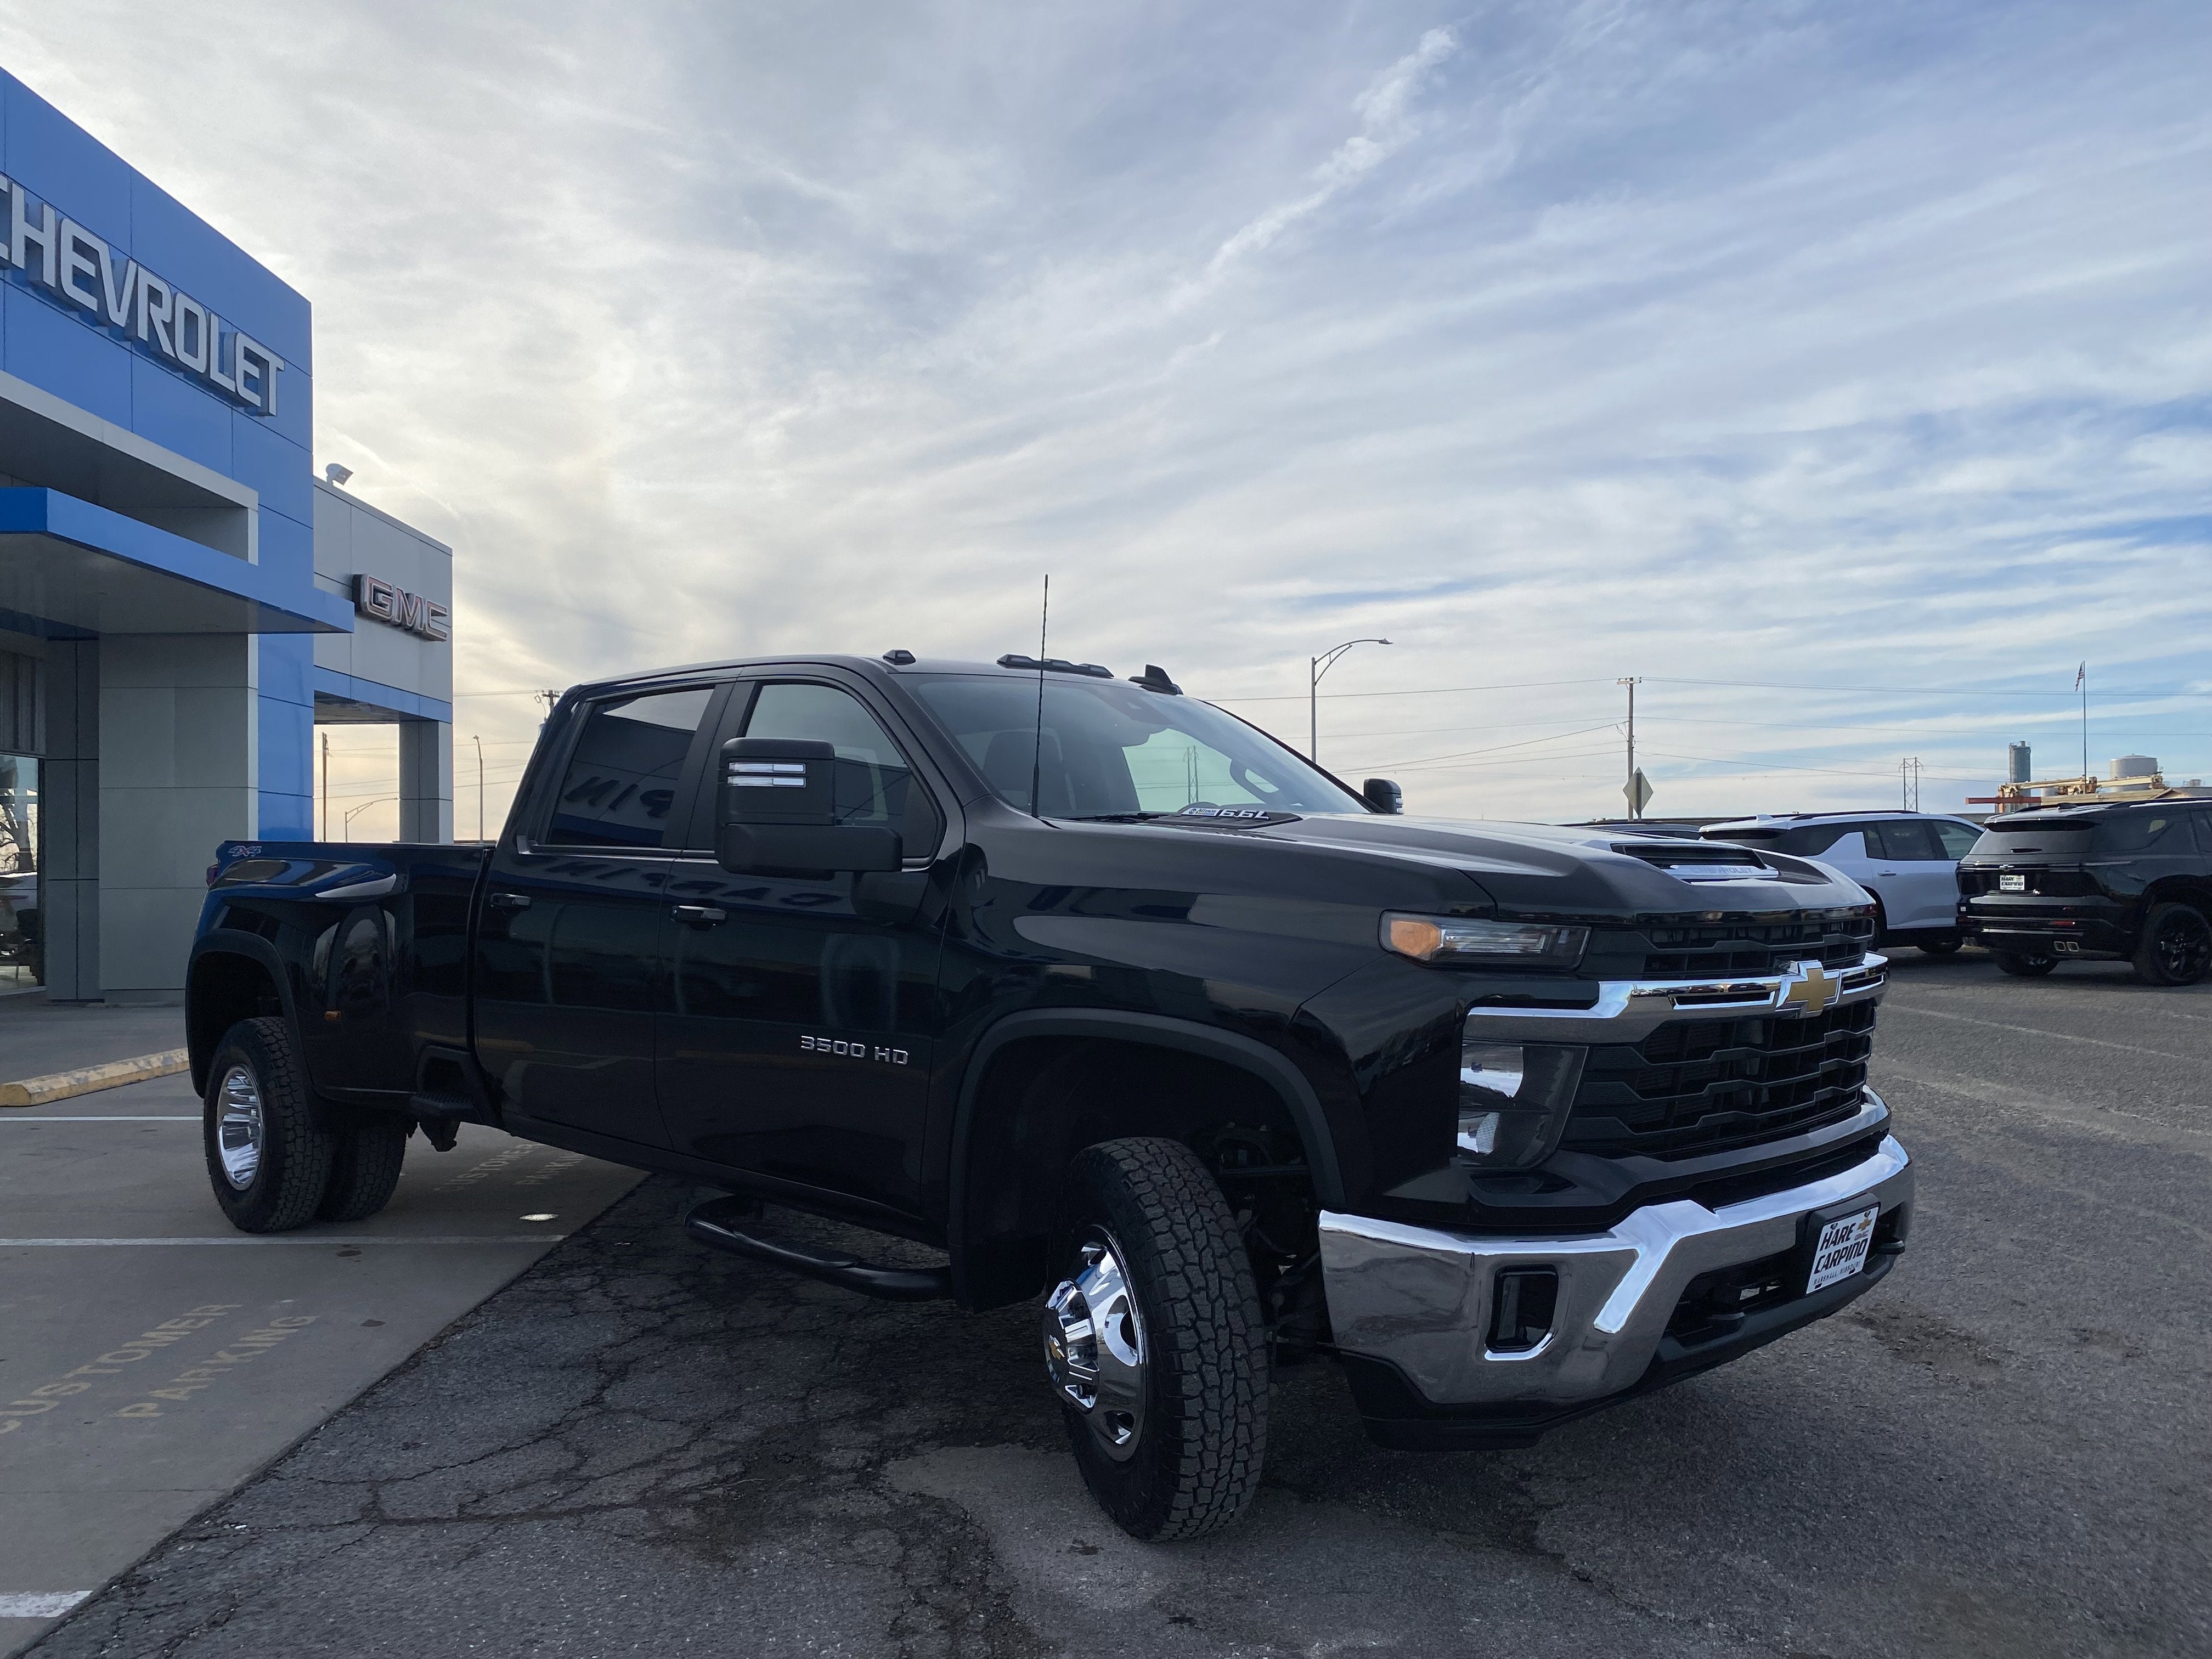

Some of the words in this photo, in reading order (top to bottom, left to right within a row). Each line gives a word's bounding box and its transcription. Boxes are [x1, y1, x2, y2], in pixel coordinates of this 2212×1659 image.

[362, 575, 448, 642] GMC
[1218, 809, 1269, 819] 6.6L
[800, 1035, 865, 1058] 3500
[874, 1047, 909, 1065] HD
[1819, 1223, 1857, 1251] HARE
[1814, 1238, 1869, 1274] CARPINO
[111, 1315, 319, 1418] PARKING
